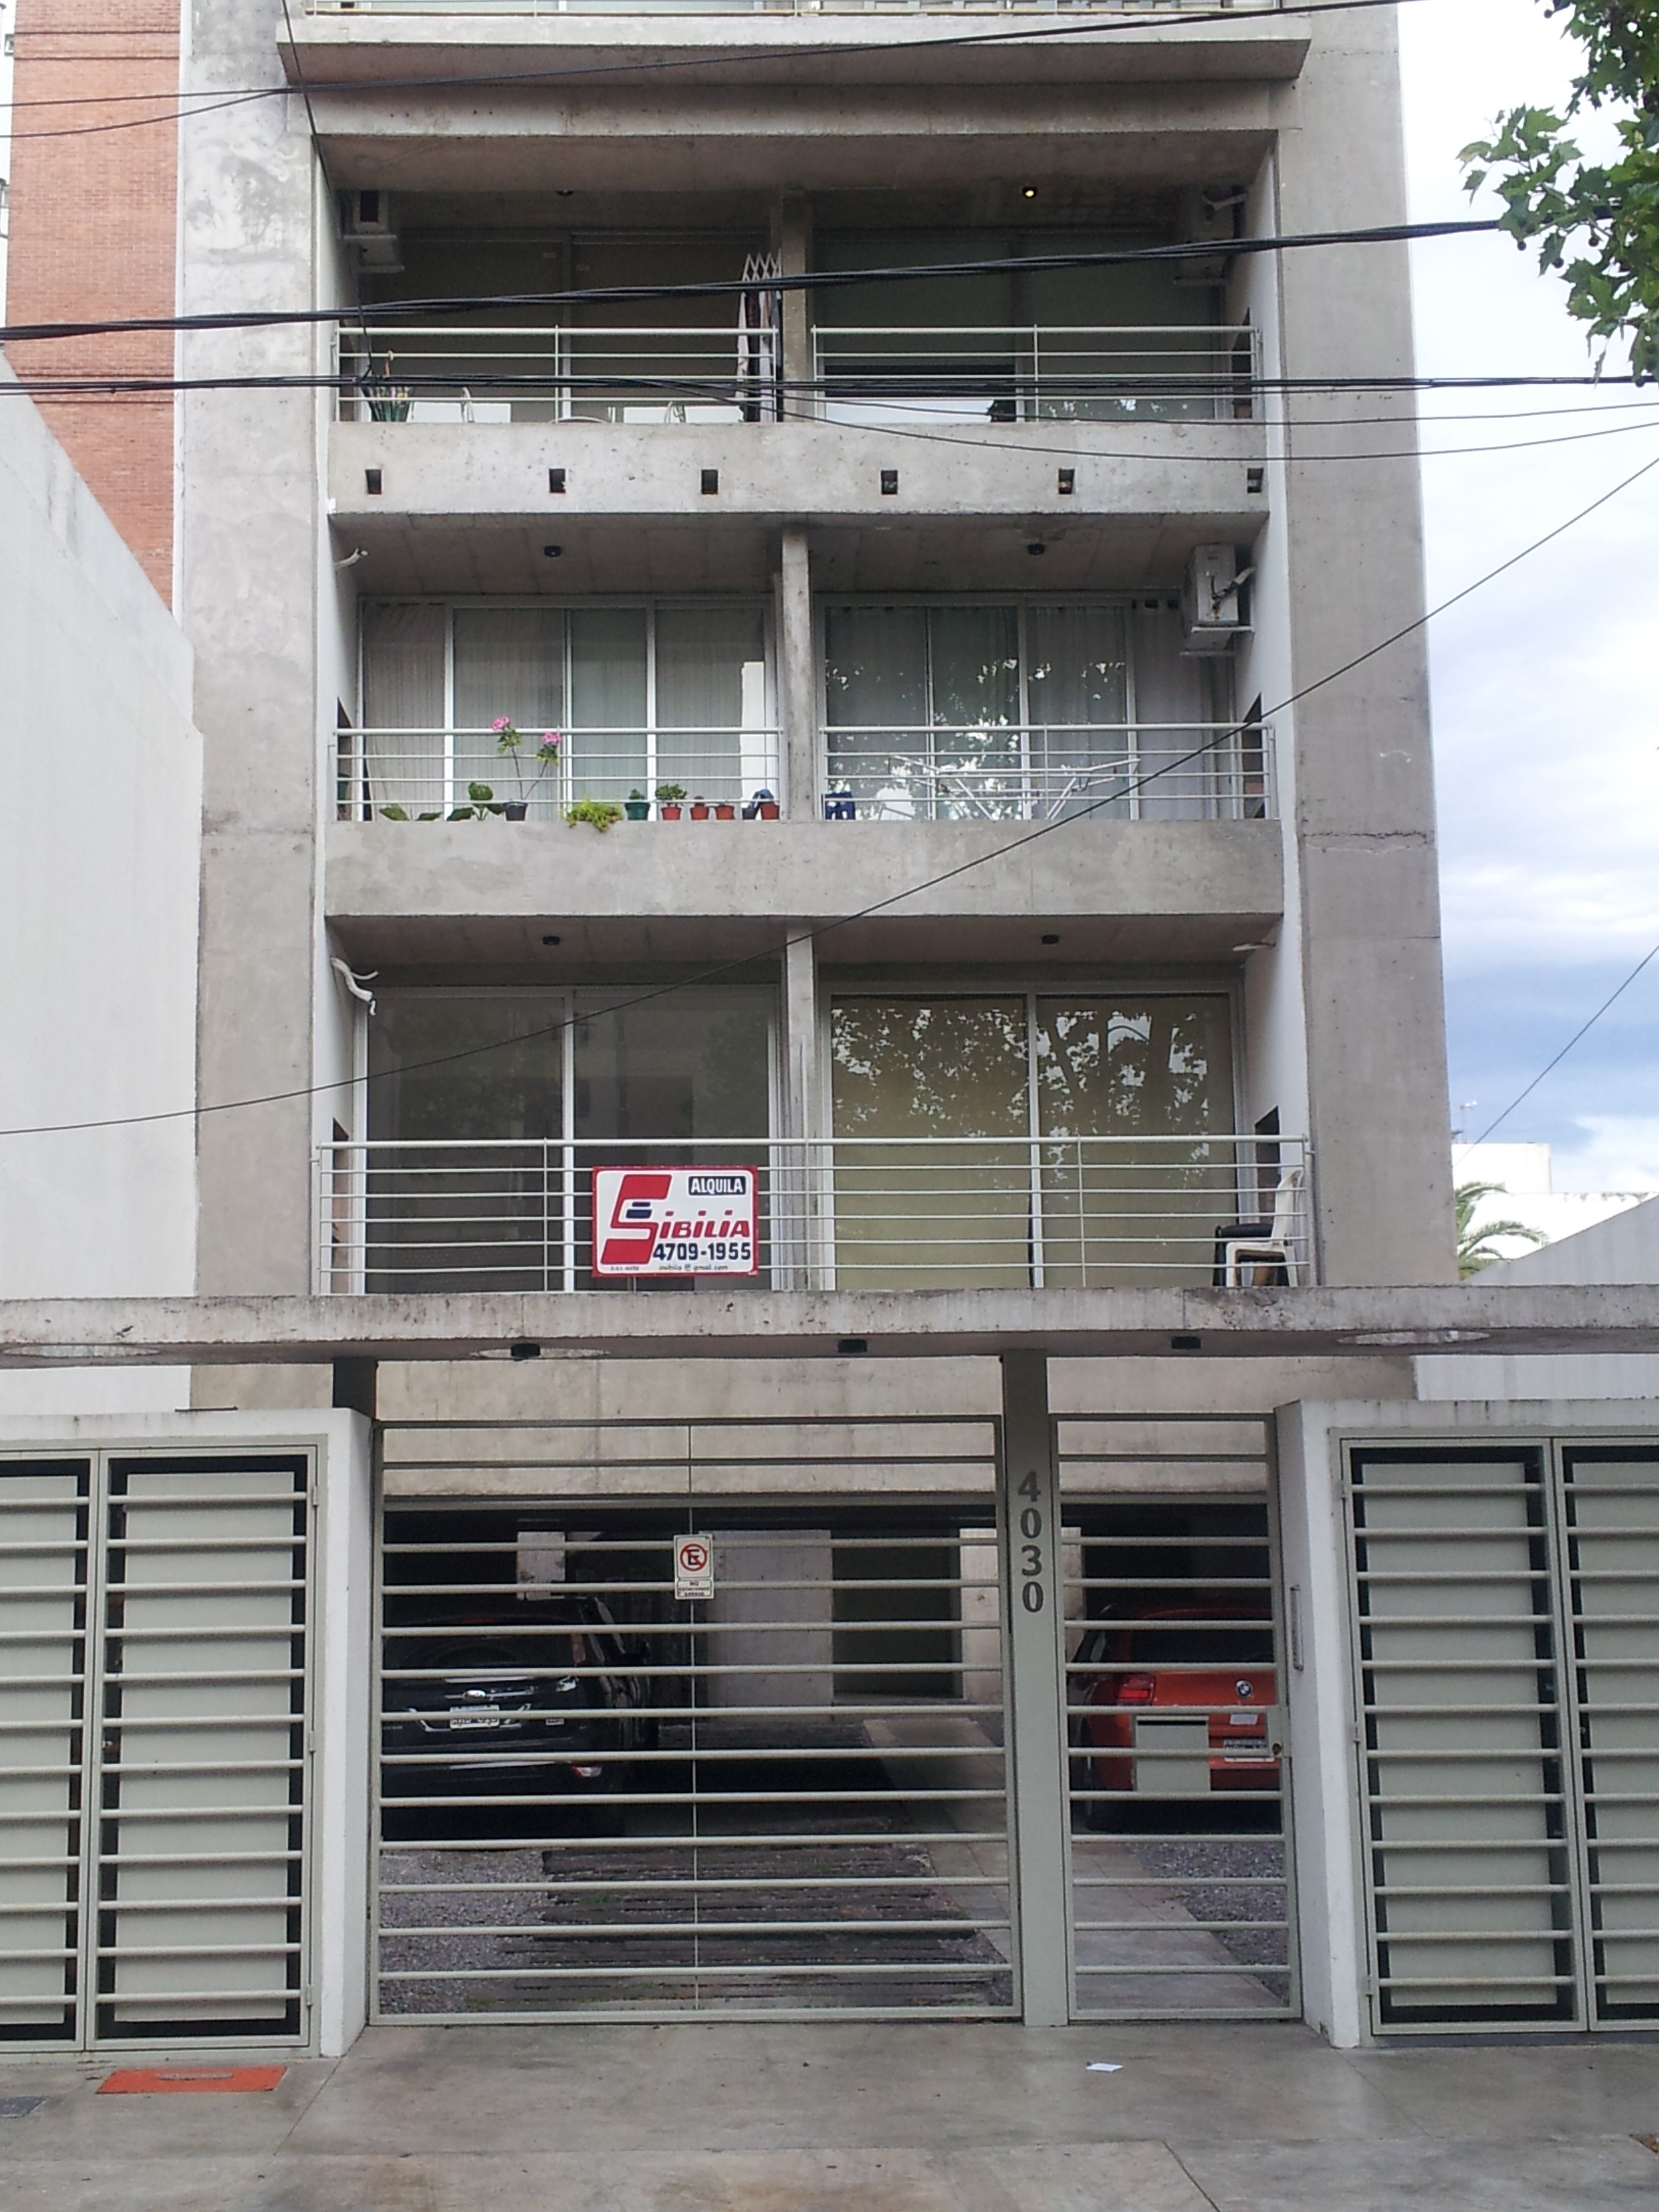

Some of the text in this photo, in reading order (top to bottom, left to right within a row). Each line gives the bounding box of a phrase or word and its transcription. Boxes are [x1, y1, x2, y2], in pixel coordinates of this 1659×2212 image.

[691, 1178, 743, 1193] ALQUILA
[653, 1242, 752, 1261] 4709-1955
[1018, 1470, 1044, 1613] 4030
